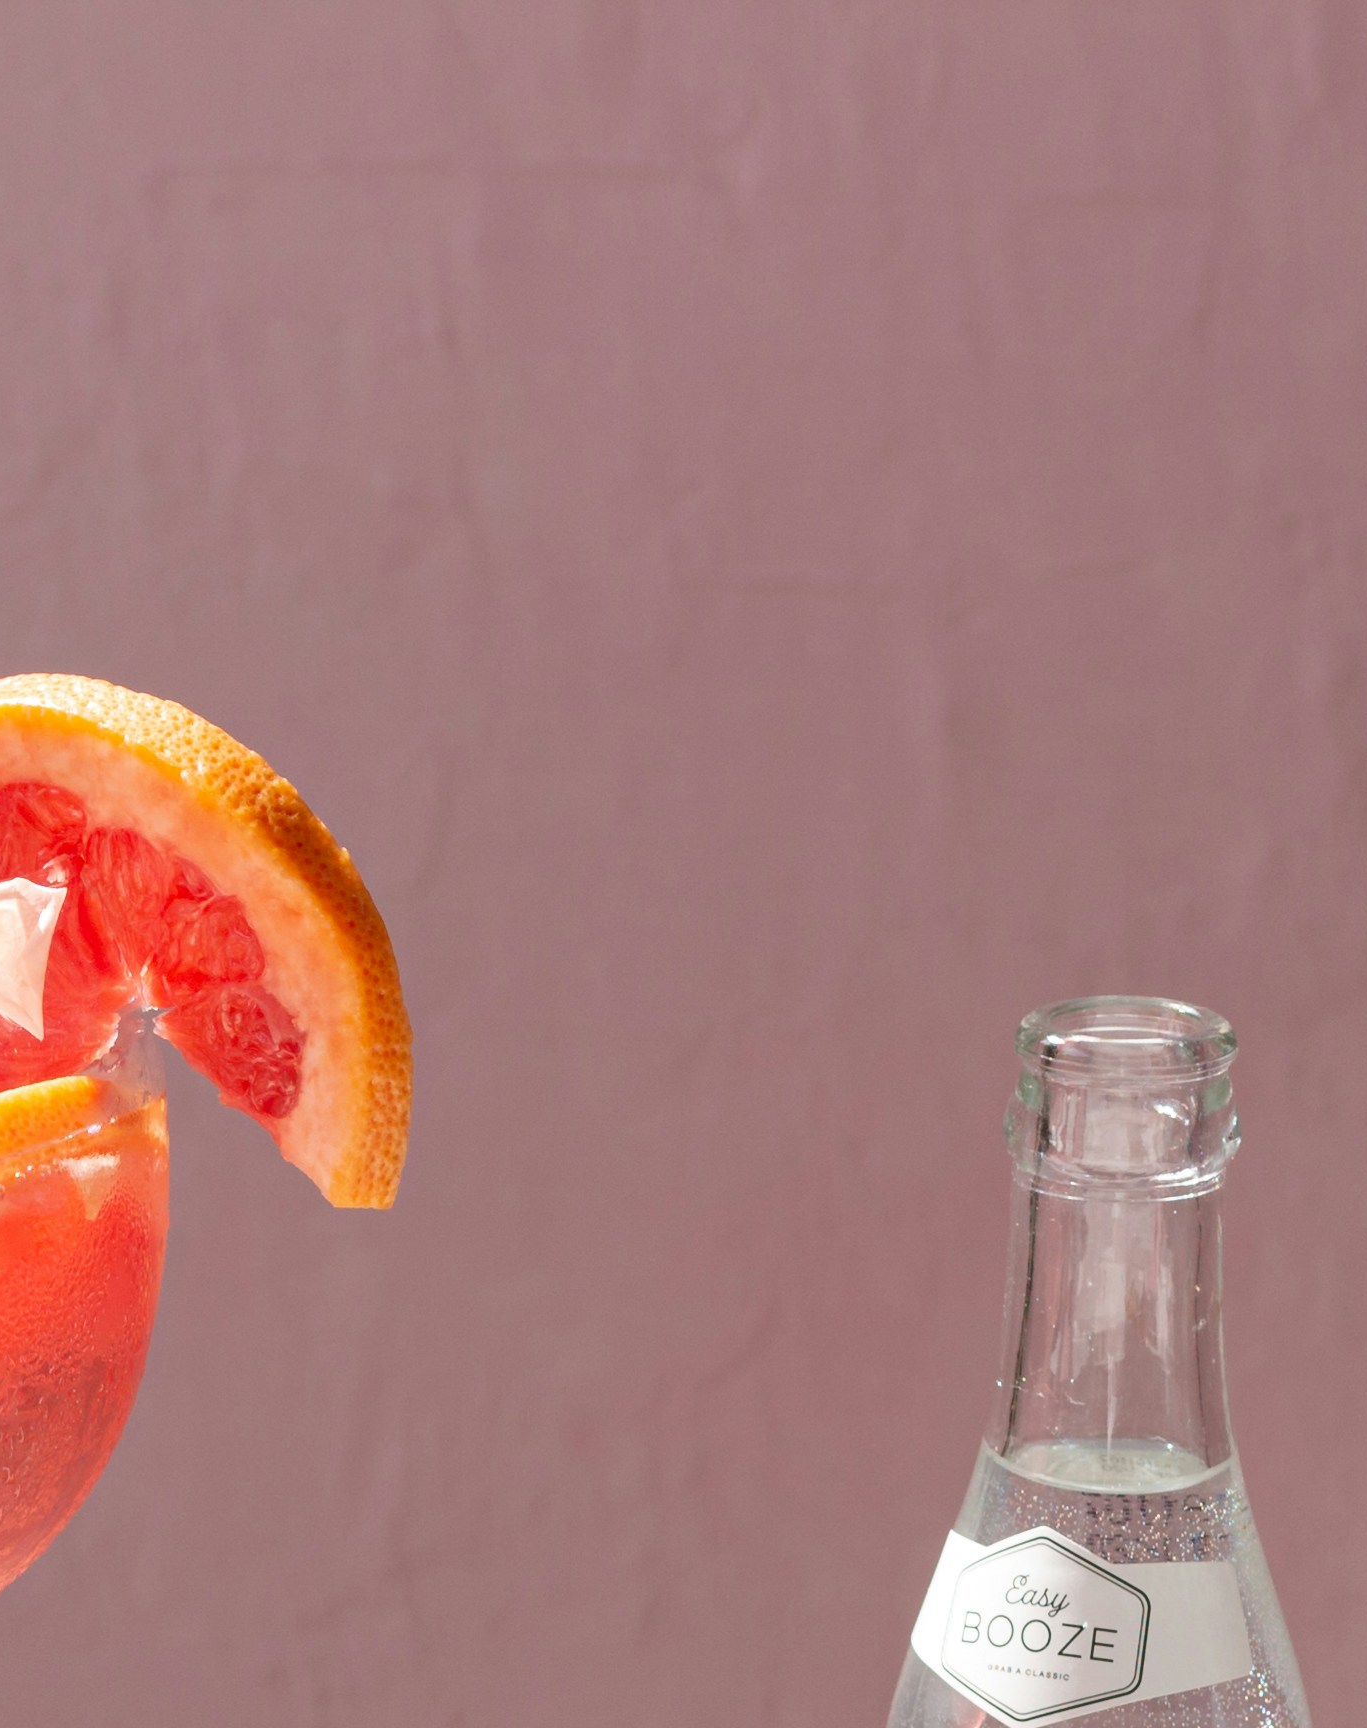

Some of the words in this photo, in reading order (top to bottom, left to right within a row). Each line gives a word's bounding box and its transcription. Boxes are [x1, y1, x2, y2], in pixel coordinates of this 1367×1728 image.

[1005, 1574, 1070, 1617] Easy
[961, 1611, 1118, 1663] BOOZE
[987, 1664, 1012, 1673] GRAB
[1025, 1668, 1070, 1681] CLASSIC
